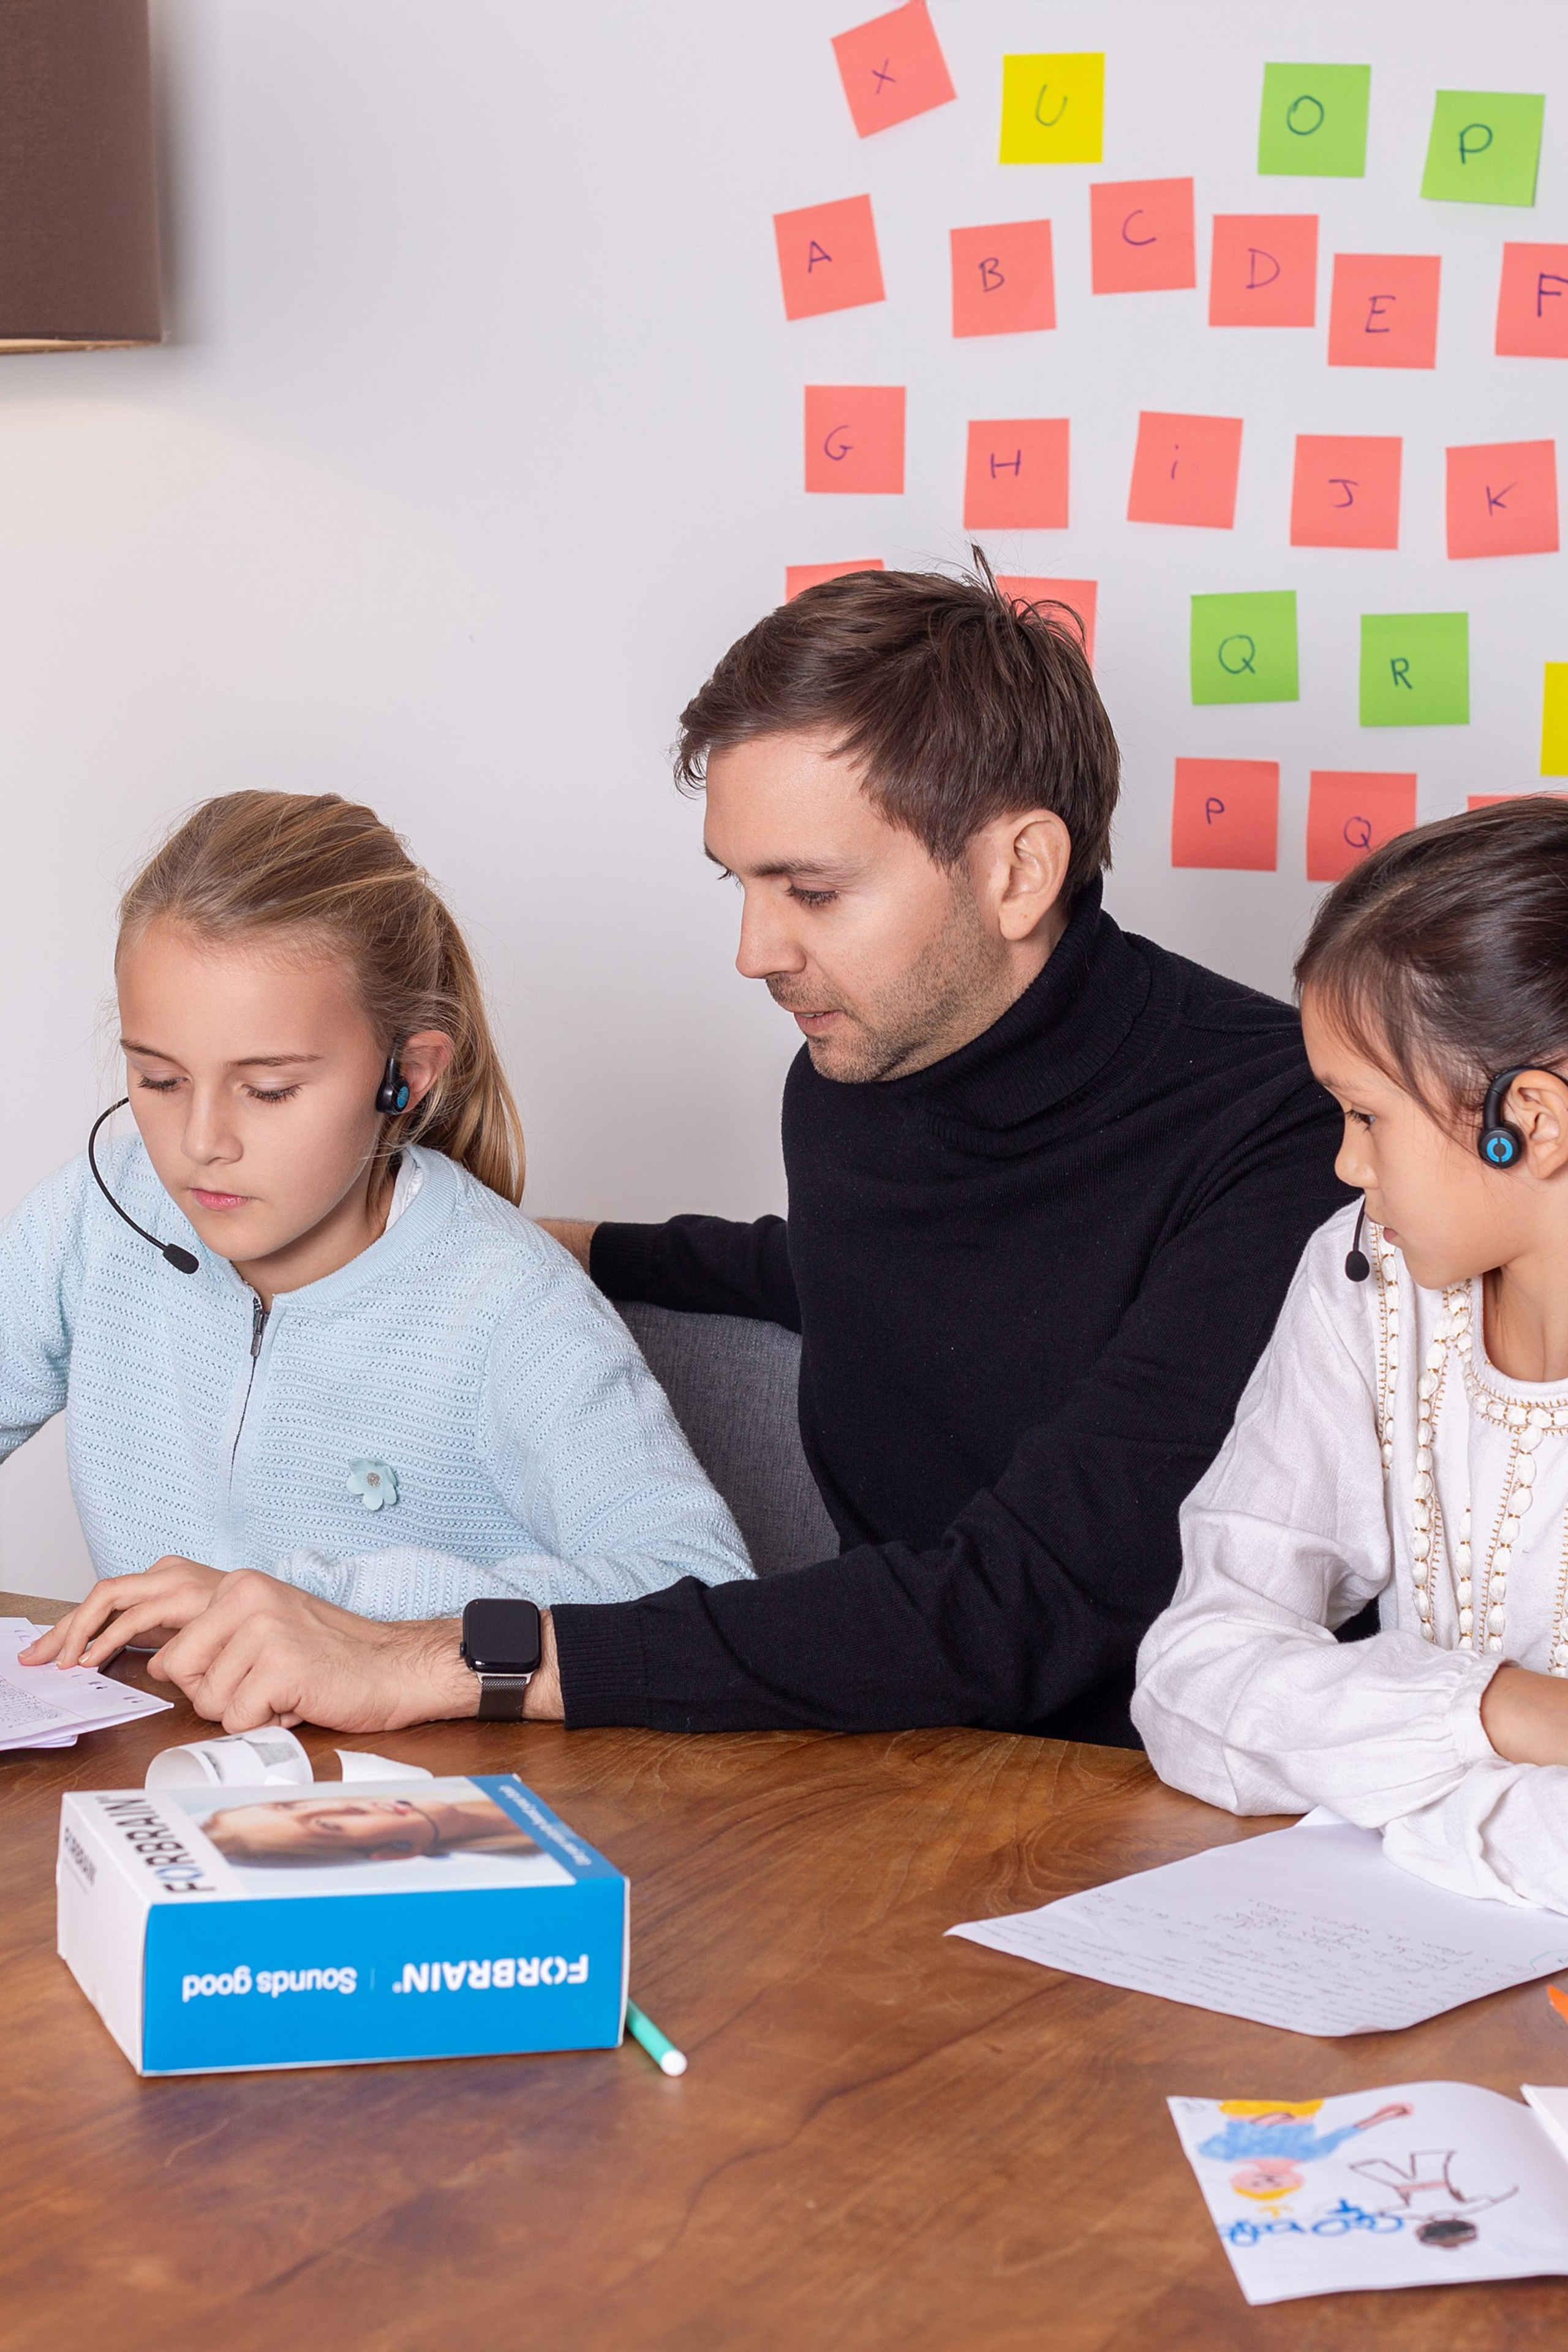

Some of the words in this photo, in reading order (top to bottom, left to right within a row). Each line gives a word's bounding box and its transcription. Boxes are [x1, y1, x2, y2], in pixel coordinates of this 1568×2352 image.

[872, 59, 896, 94] X
[1035, 83, 1069, 127] U
[1459, 124, 1493, 165] P
[1123, 210, 1157, 246] C
[808, 241, 833, 274] A
[979, 257, 1005, 292] B
[1246, 249, 1280, 289] D
[1537, 273, 1568, 318] F
[1365, 295, 1396, 334] E
[824, 425, 853, 461] G
[990, 449, 1022, 479] H
[1329, 479, 1359, 508] J
[1487, 481, 1519, 516] K
[1218, 635, 1256, 675] Q
[1390, 657, 1413, 690] R
[1205, 797, 1226, 825] P
[1344, 816, 1371, 851] Q
[182, 1965, 253, 2003] good
[256, 1967, 358, 1999] Sounds
